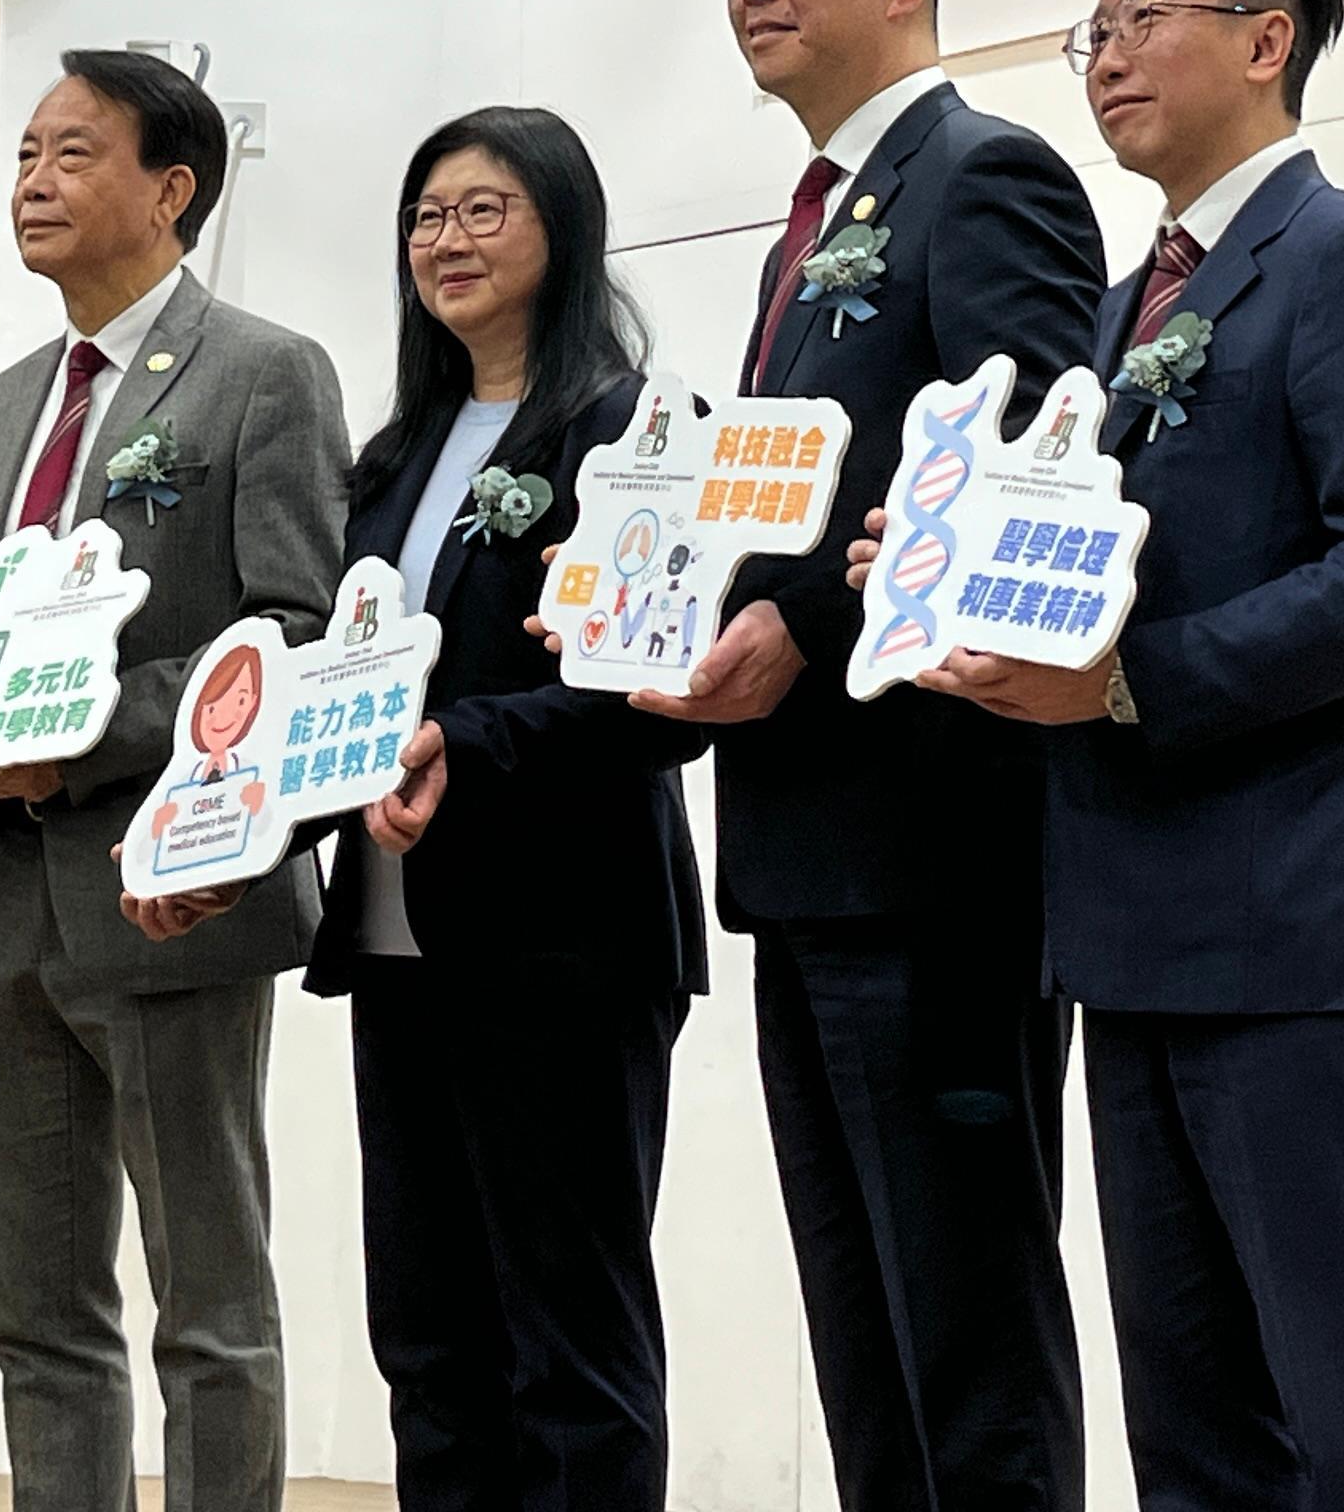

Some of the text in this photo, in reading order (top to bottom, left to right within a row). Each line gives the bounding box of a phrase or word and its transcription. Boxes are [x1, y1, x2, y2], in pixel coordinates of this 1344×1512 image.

[3, 656, 95, 701] 多元化
[285, 682, 410, 747] 能力為本
[279, 731, 402, 796] 醫學教育
